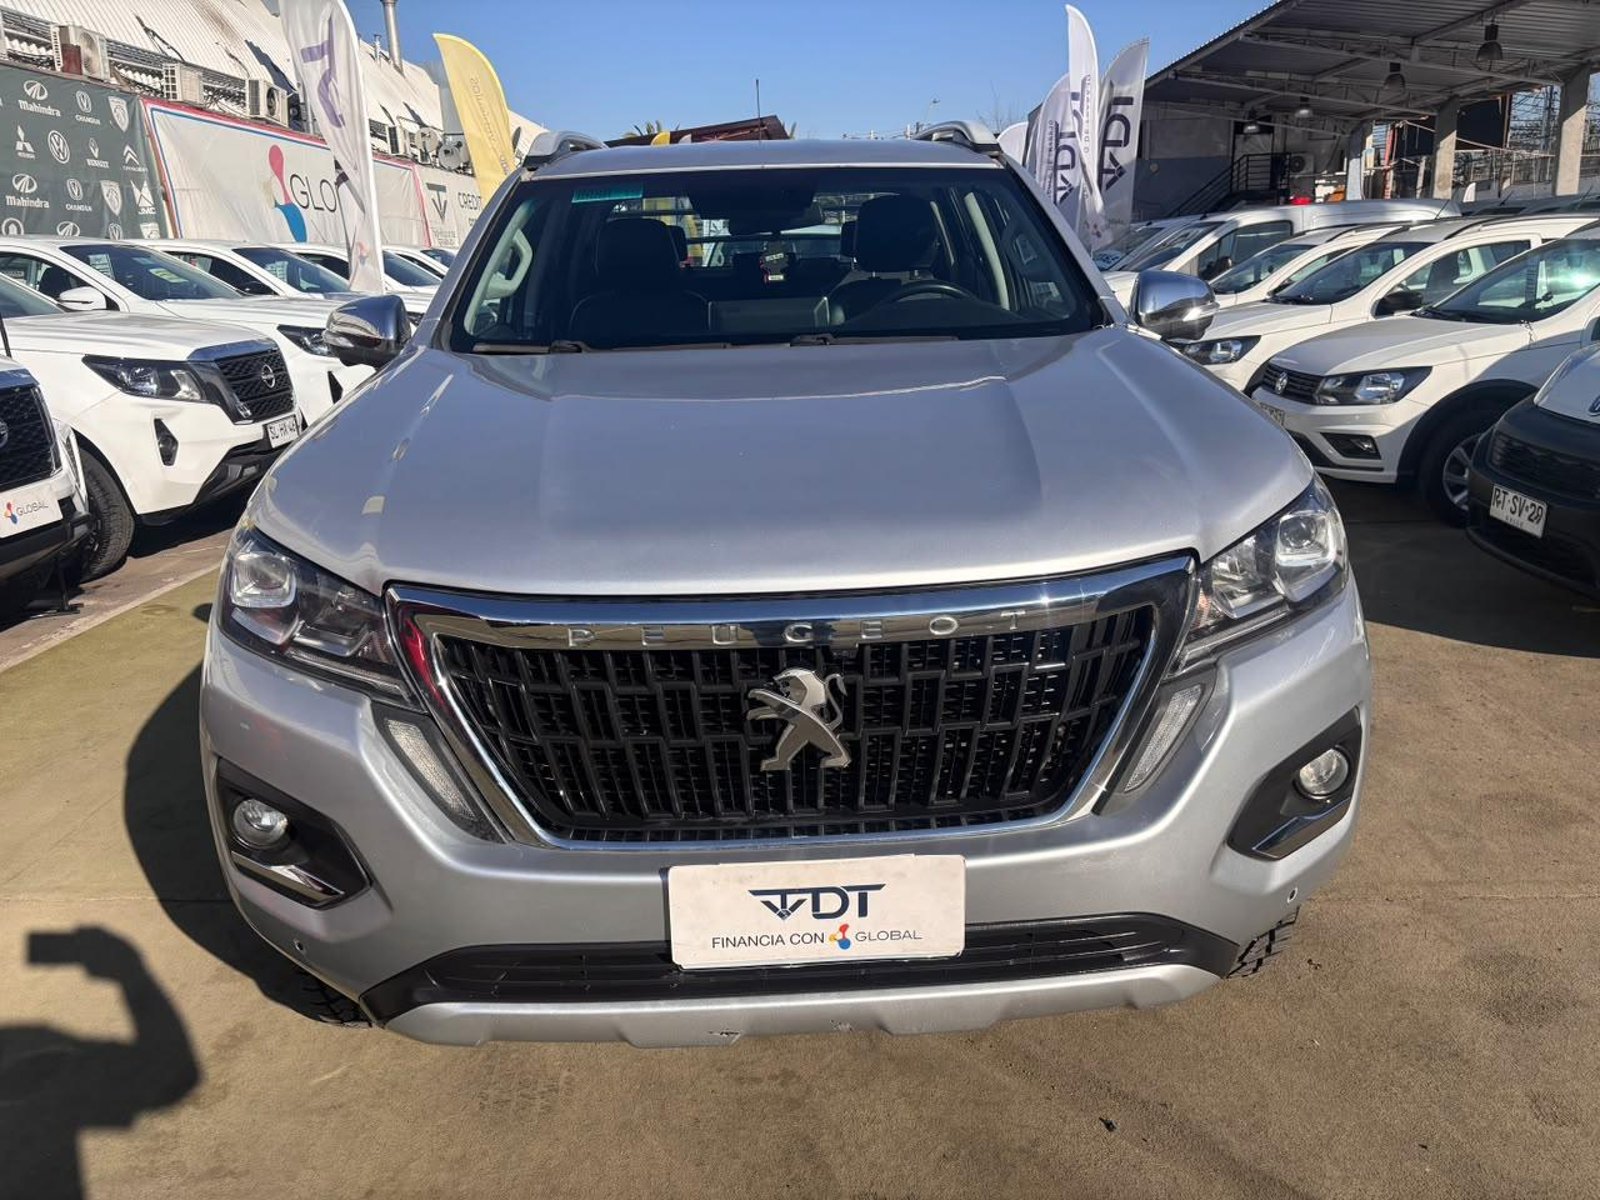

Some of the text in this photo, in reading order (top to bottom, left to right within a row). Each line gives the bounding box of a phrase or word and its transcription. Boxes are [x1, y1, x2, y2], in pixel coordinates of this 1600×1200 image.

[18, 100, 61, 117] Mahindra
[5, 195, 50, 209] Mahindra
[137, 207, 157, 215] JMC
[567, 609, 1026, 648] PEUGEOT
[711, 929, 923, 949] FINANCIA CON GLOBAL
